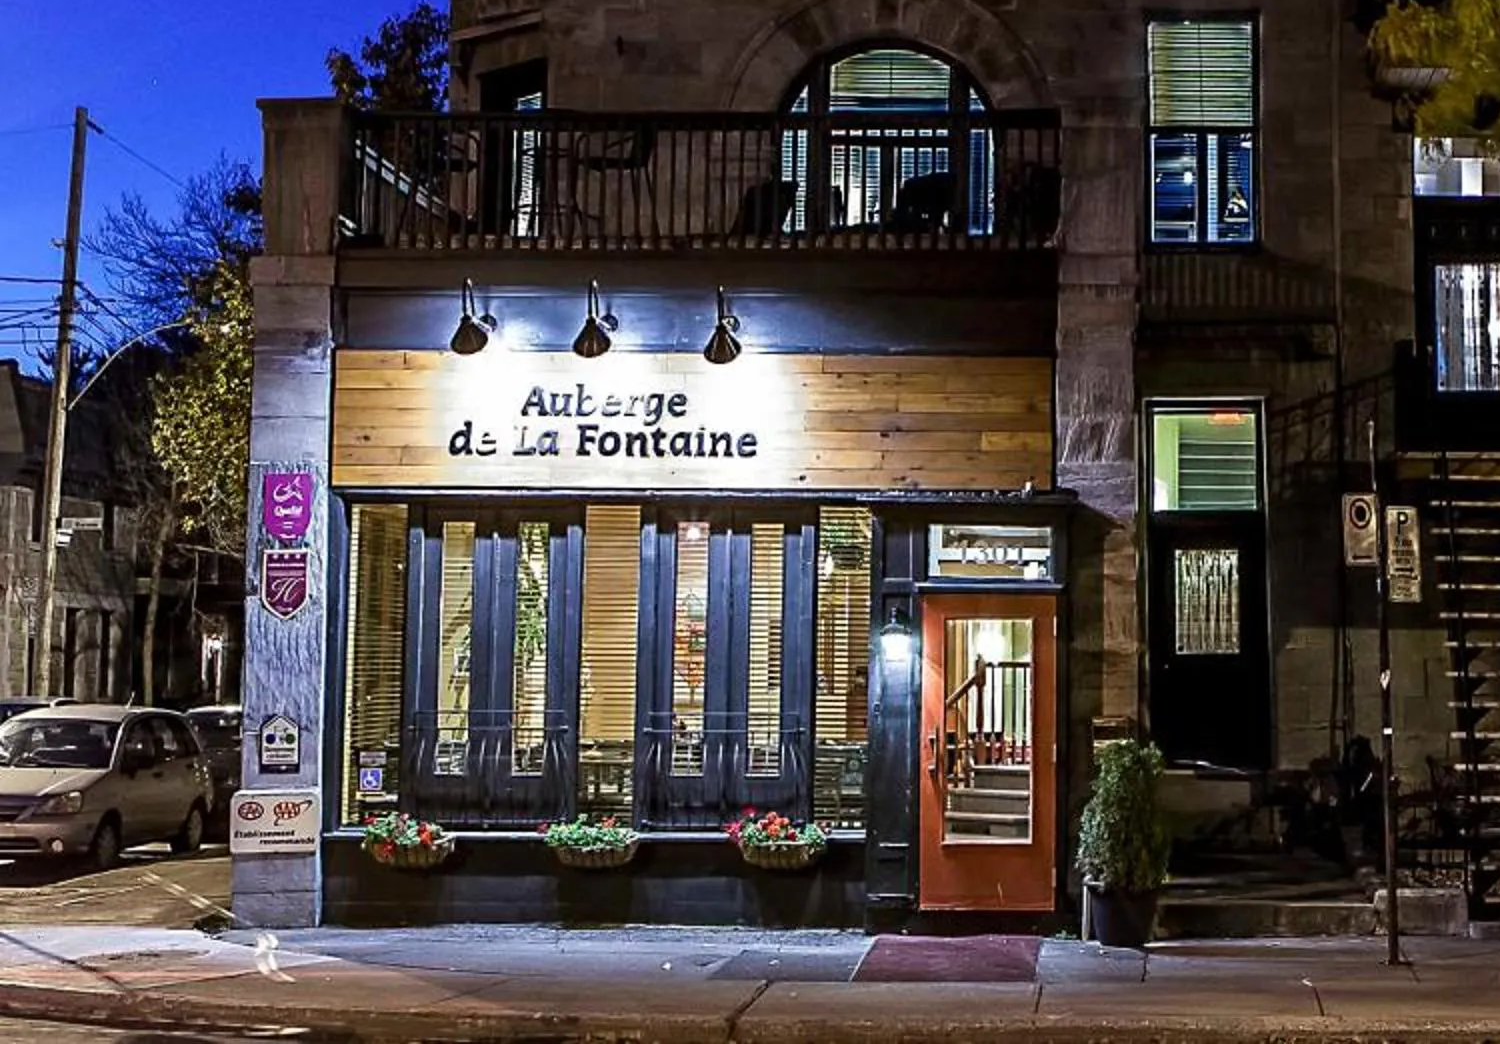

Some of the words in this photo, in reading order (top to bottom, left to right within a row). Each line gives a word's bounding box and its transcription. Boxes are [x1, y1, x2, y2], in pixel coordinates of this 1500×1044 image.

[520, 383, 688, 426] Auberge
[448, 421, 497, 456] de
[512, 424, 560, 456] La
[575, 423, 758, 458] Fontaine
[958, 539, 1025, 565] 1301
